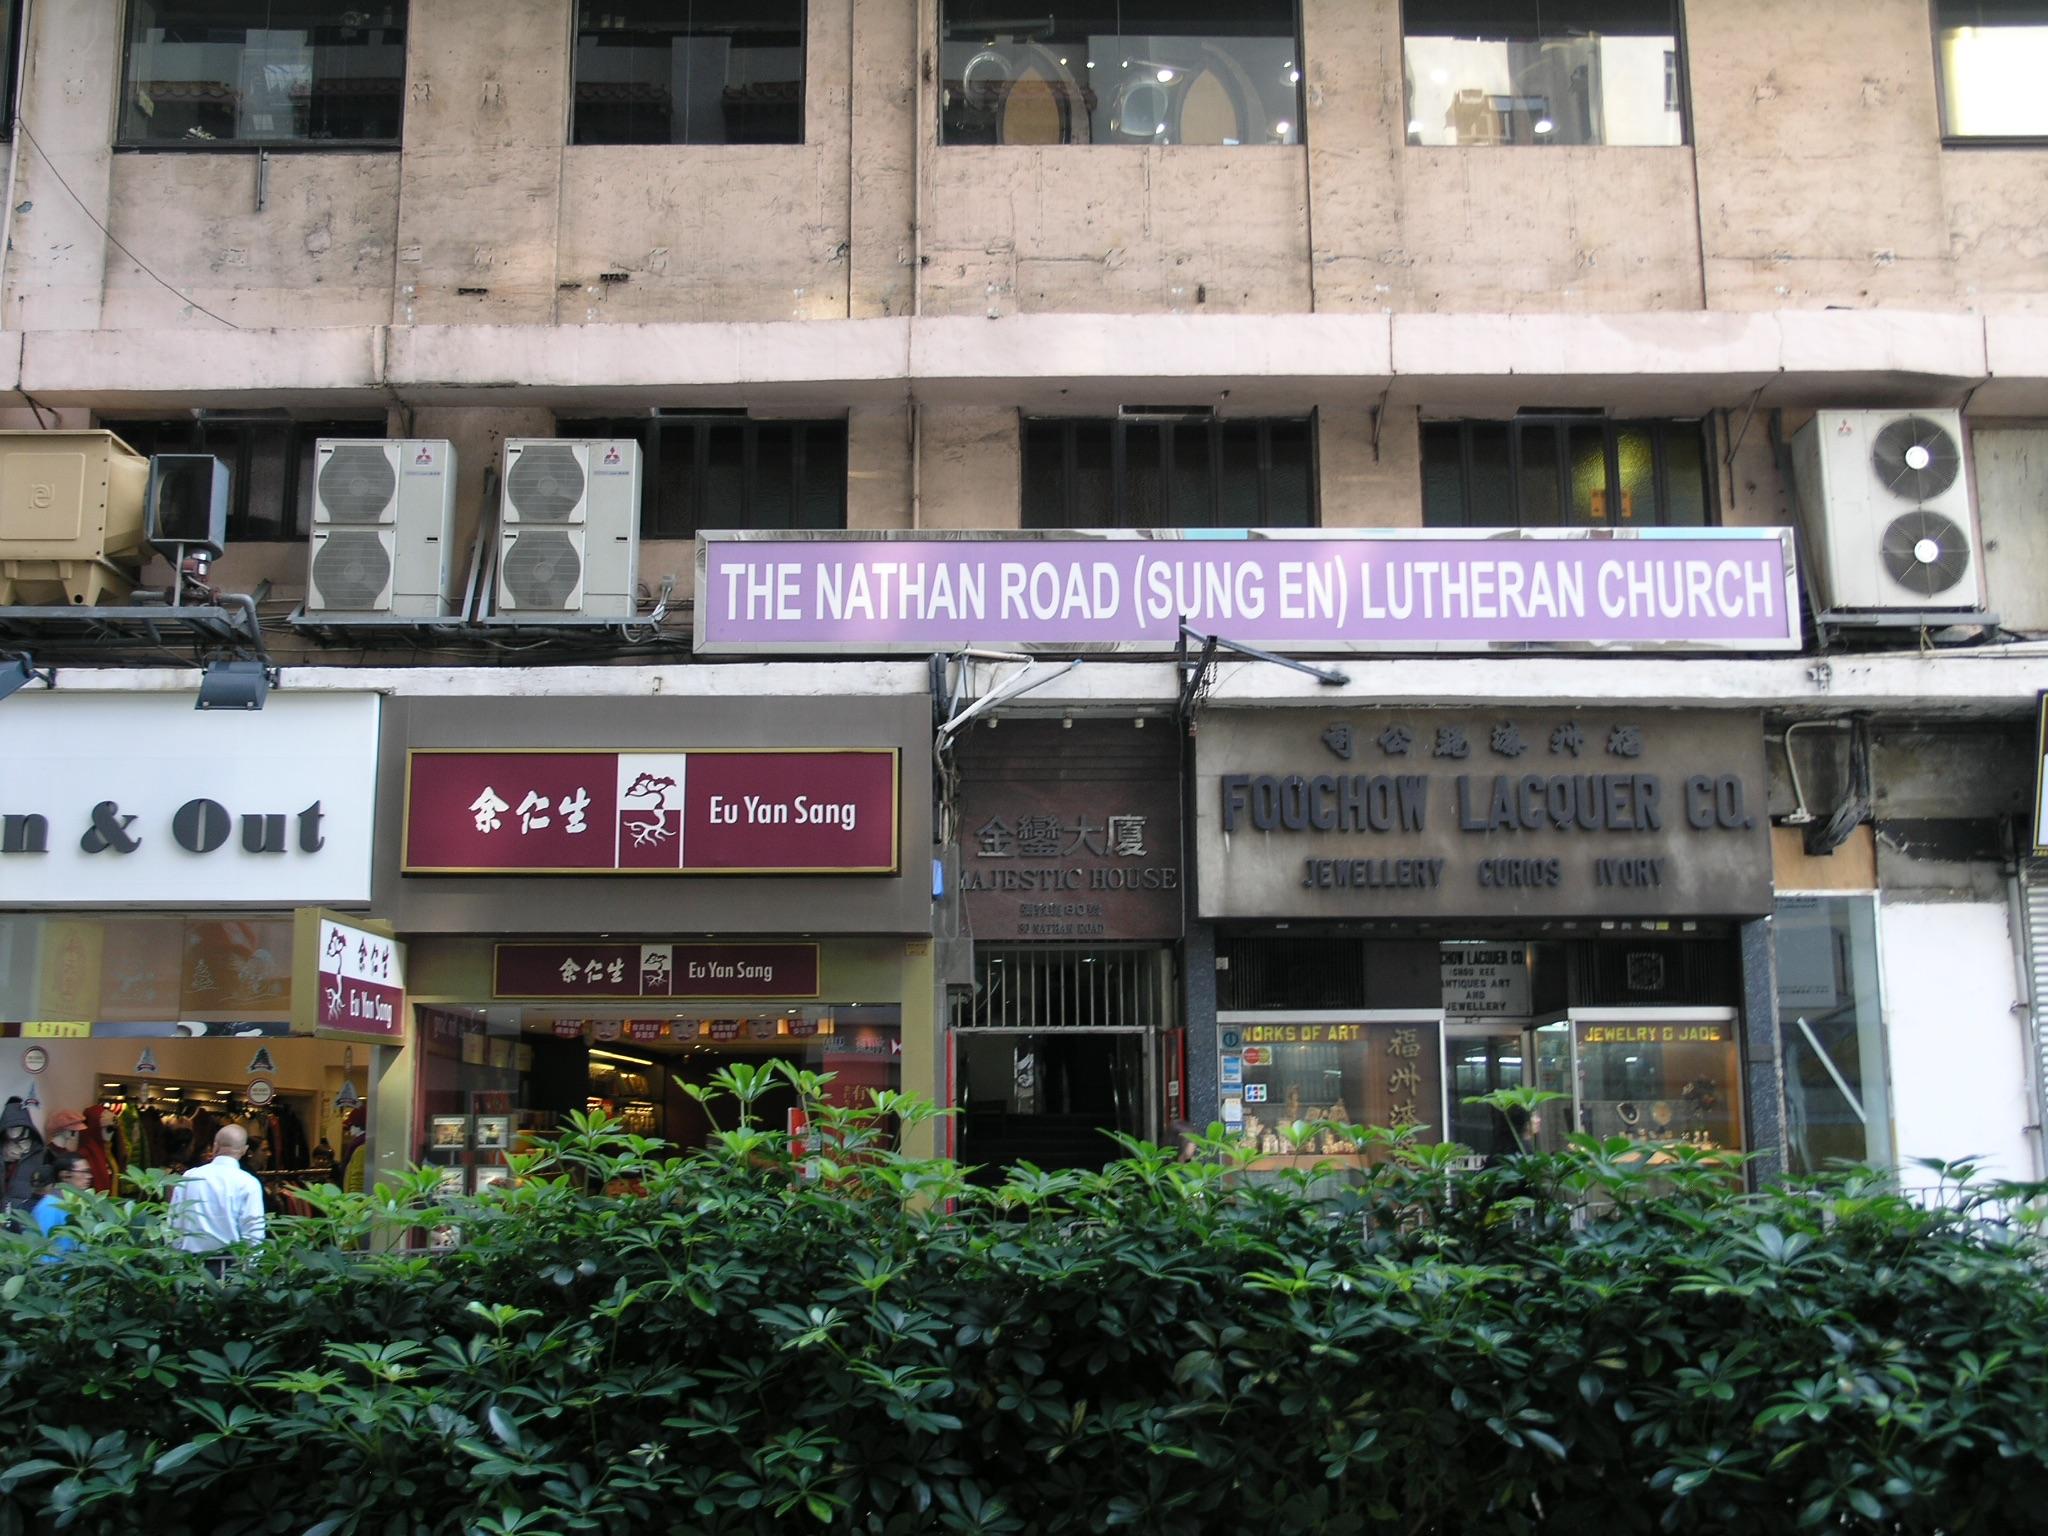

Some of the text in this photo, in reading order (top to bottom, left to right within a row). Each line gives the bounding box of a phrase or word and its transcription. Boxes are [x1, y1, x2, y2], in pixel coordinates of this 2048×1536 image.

[720, 554, 1774, 628] THE NATHAN ROAD (SUNG EN) LUTHERAN CHURCH
[468, 785, 593, 835] 余仁生
[709, 795, 857, 831] Eu Yan Sang
[1222, 774, 1427, 832] FOOCHOW
[1459, 774, 1661, 832] LACQUER
[80, 800, 143, 854] &
[172, 798, 325, 854] Out
[1089, 867, 1177, 890] HOUSE
[1302, 856, 1667, 889] JEWELLERY CURIOS IVORY
[558, 958, 625, 984] 余仁生
[688, 961, 774, 983] Eu Yan Sang
[1490, 979, 1511, 988] ART
[351, 989, 392, 1028] Eu Yan Sang
[1445, 1002, 1507, 1012] JEWELLERY
[1300, 1025, 1322, 1041] OF
[1327, 1025, 1360, 1041] ART
[1583, 1026, 1657, 1042] JEWELRY
[1678, 1026, 1721, 1041] JADE
